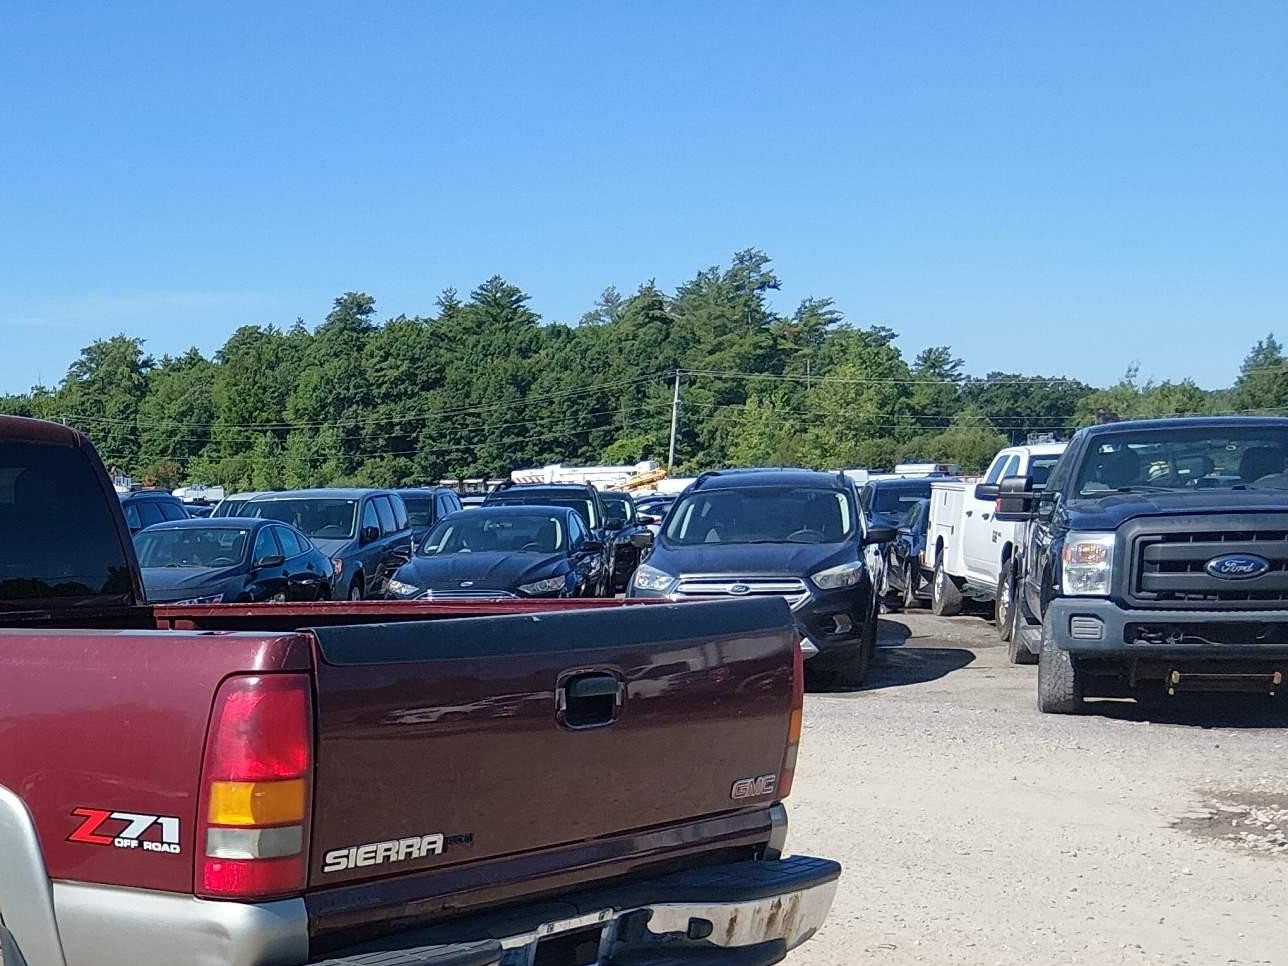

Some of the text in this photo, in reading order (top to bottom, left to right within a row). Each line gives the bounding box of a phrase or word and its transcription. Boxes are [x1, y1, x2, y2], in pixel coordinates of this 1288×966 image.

[1220, 559, 1255, 573] Ford
[730, 773, 776, 800] GMC
[66, 806, 180, 846] Z71
[114, 837, 181, 854] OFF ROAD
[323, 832, 444, 873] SIERRA
